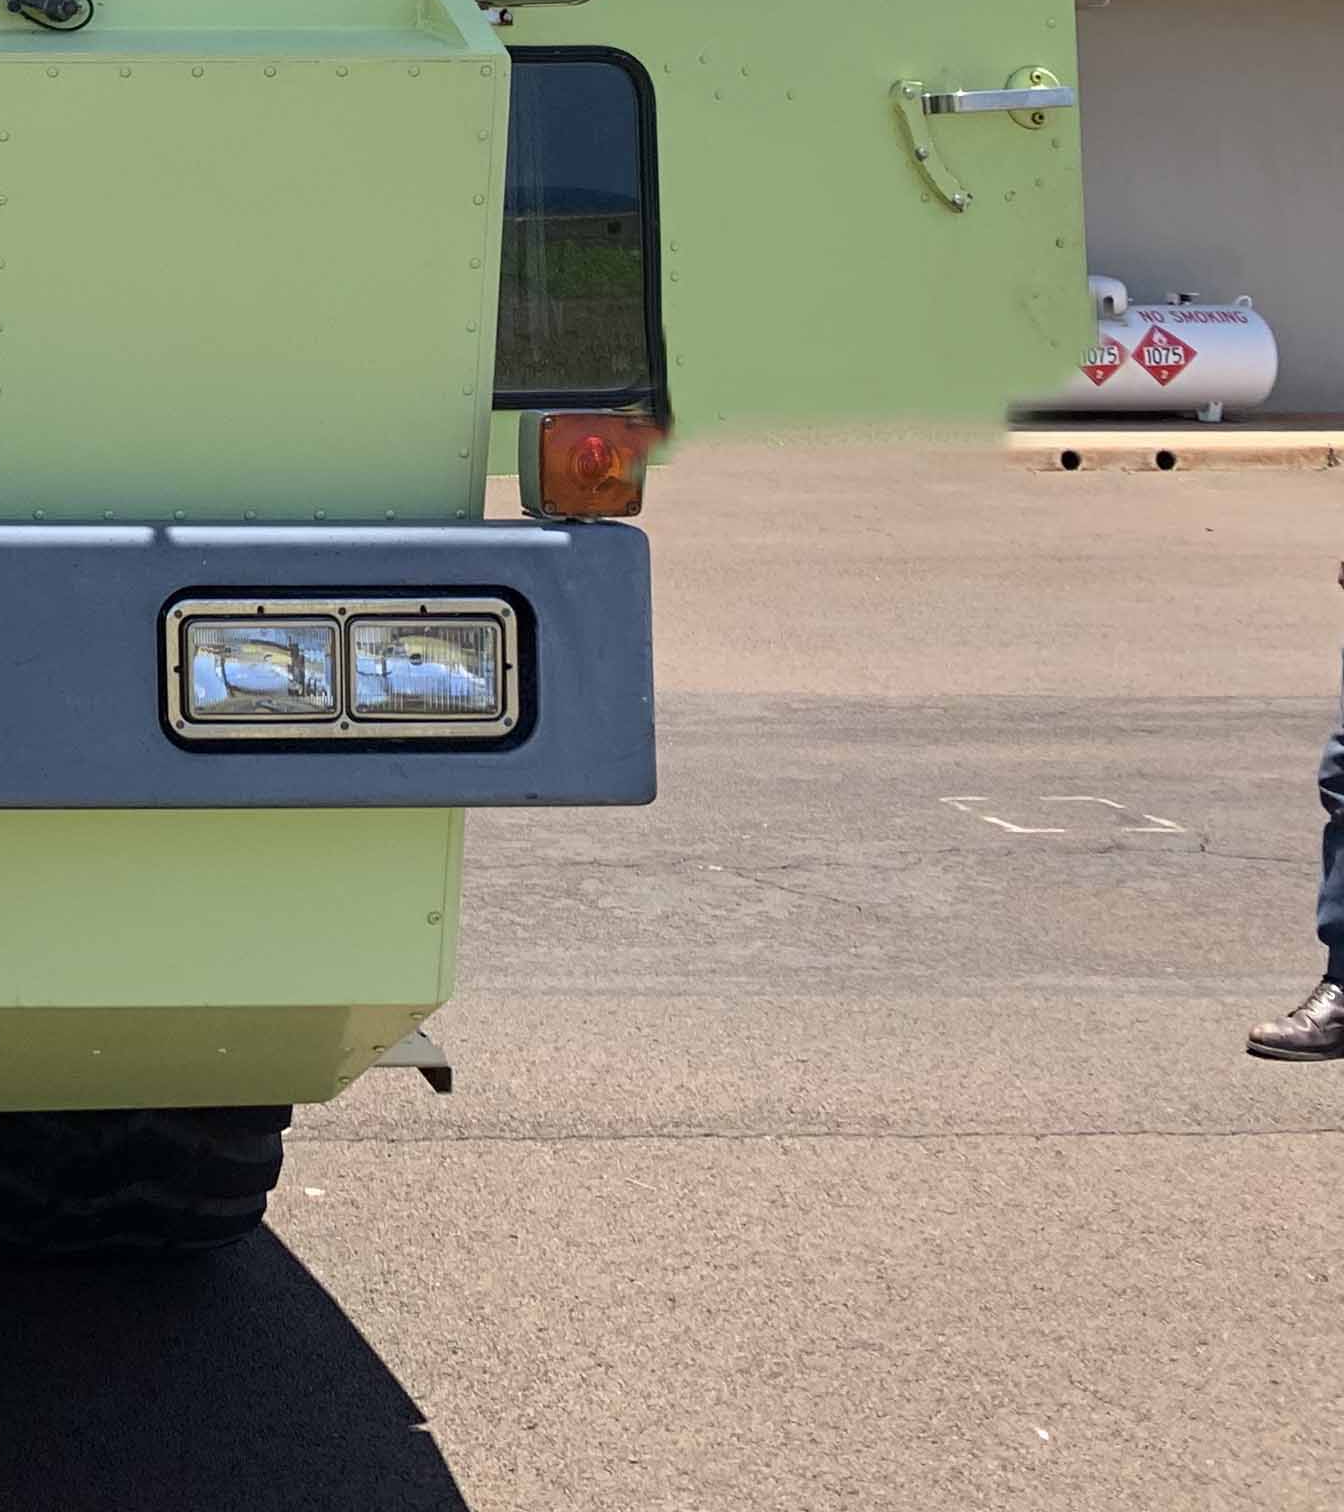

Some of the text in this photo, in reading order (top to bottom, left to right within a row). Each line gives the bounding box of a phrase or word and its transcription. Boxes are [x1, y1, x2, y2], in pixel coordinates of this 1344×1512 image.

[1138, 310, 1249, 324] NO SMOKING
[1082, 347, 1118, 365] 1075
[1146, 347, 1183, 365] 1075
